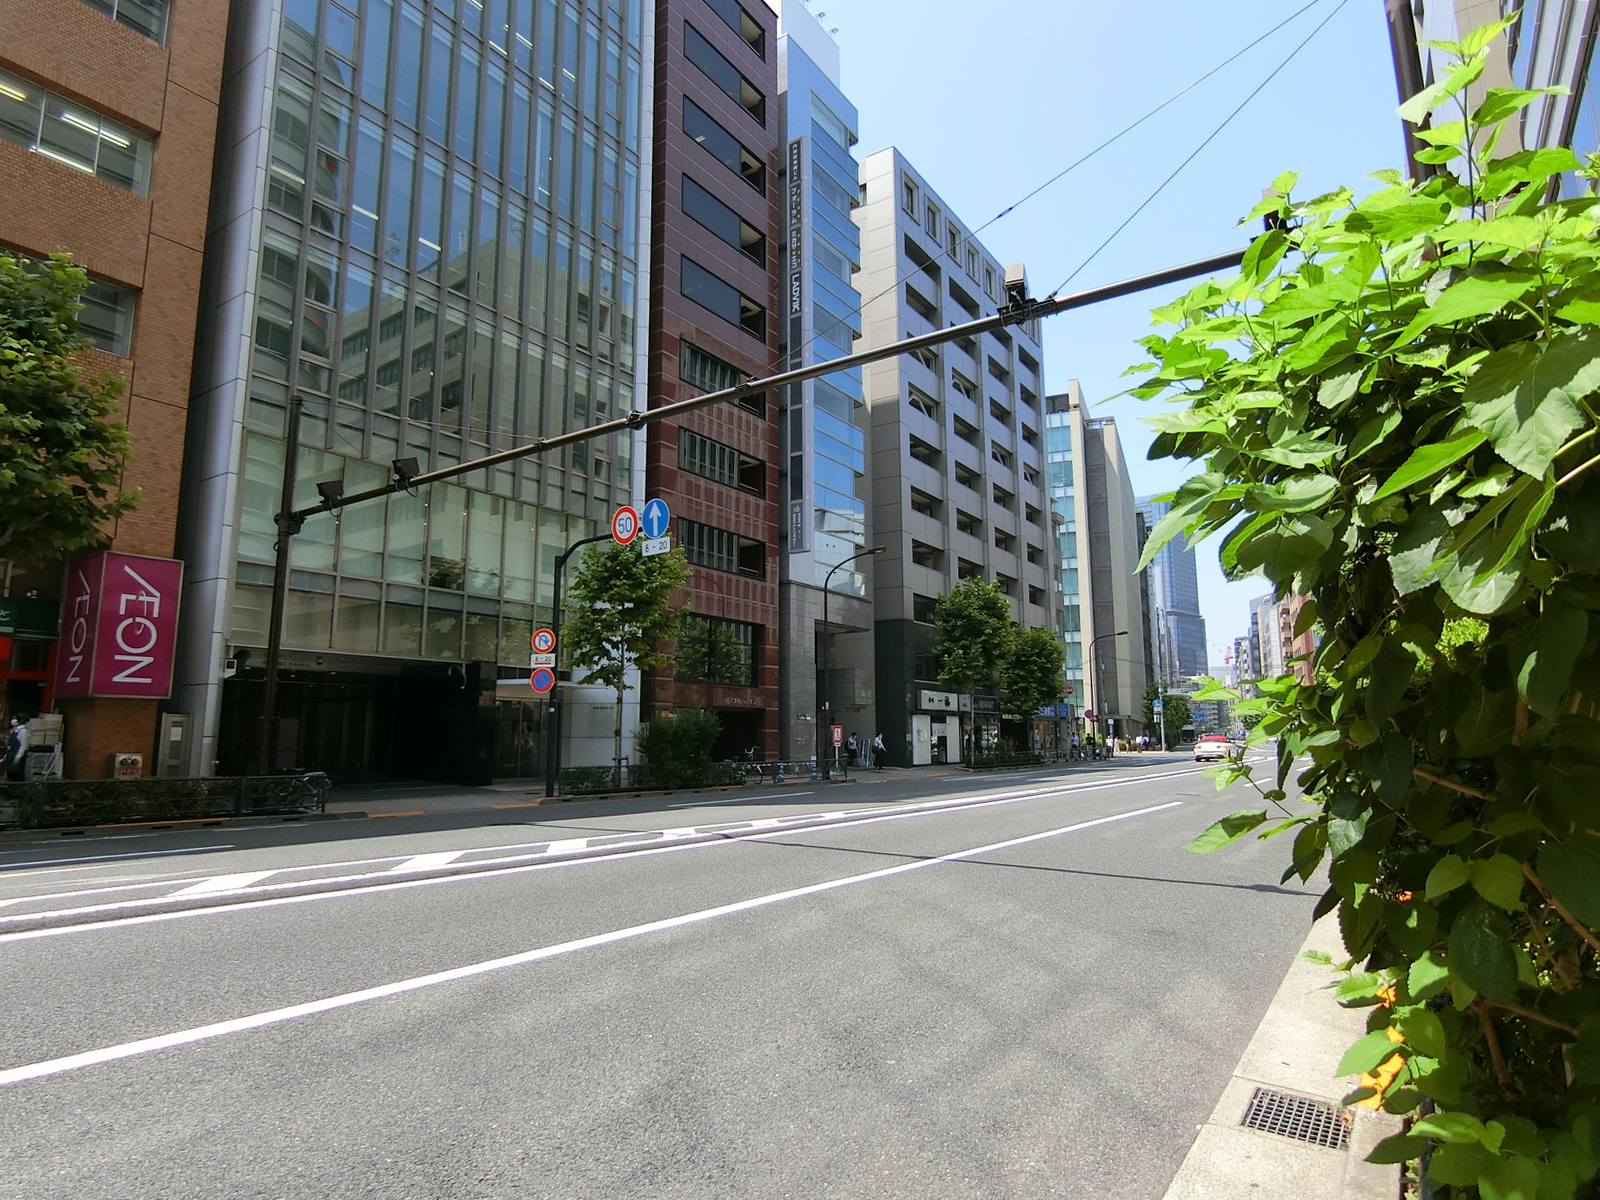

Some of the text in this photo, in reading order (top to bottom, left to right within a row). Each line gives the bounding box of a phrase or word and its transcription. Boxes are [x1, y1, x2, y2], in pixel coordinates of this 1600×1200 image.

[791, 273, 800, 313] LADVIK
[617, 517, 632, 534] 50
[66, 569, 91, 683] AEON
[112, 564, 161, 684] AEON
